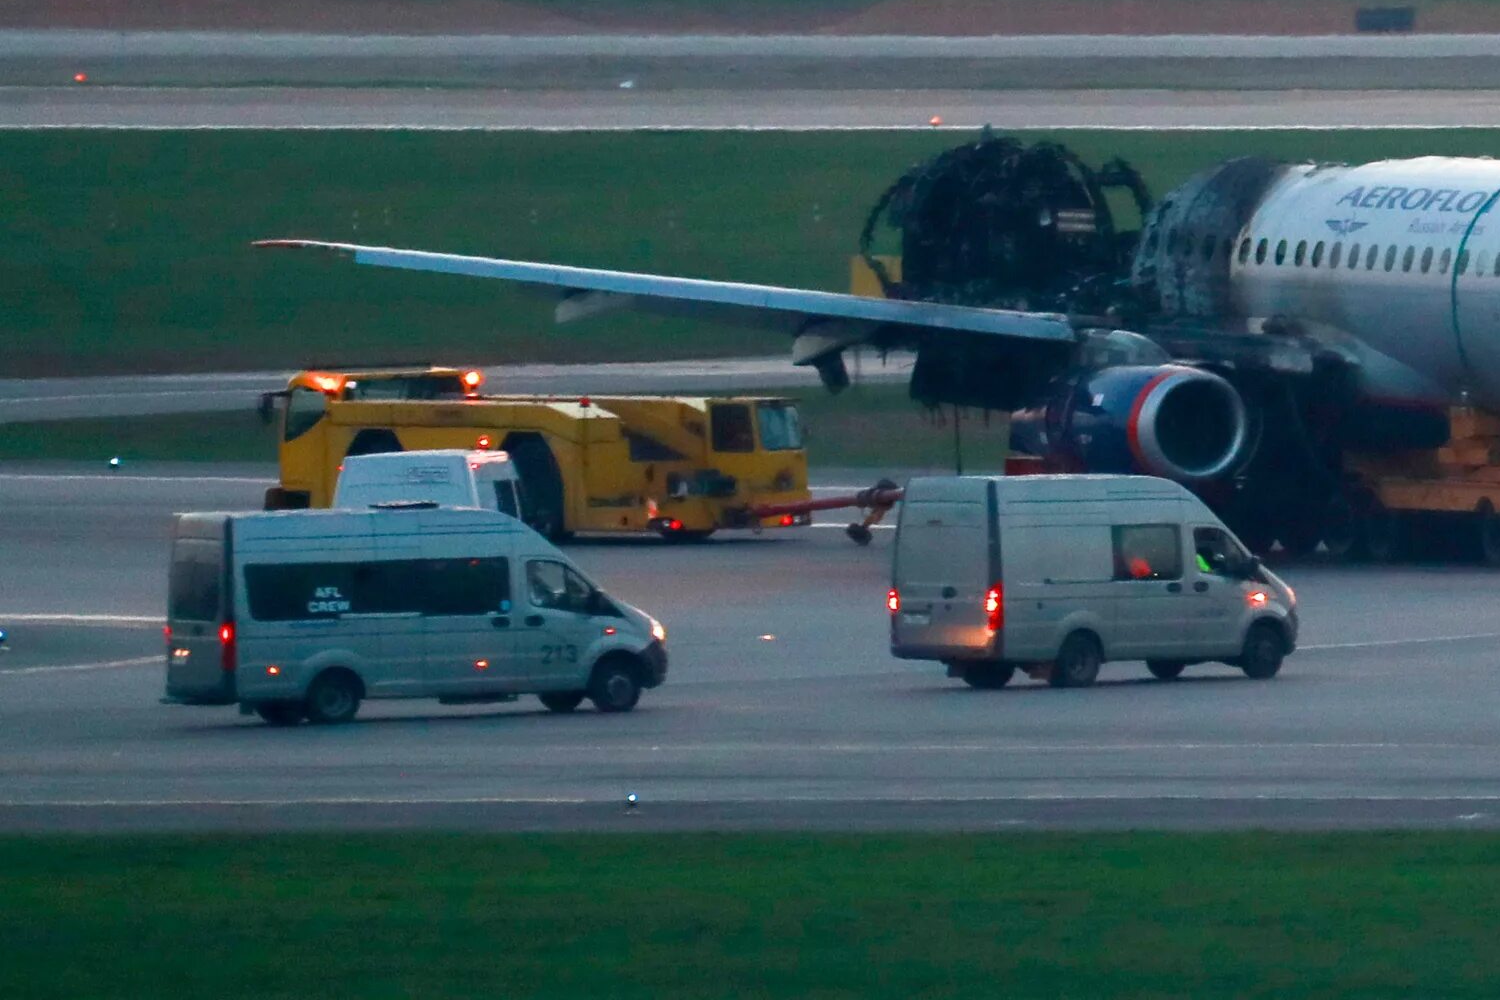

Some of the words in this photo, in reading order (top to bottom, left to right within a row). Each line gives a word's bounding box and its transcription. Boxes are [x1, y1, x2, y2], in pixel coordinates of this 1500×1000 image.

[315, 587, 342, 598] AFL
[308, 601, 350, 612] CREW
[541, 644, 577, 664] 213
